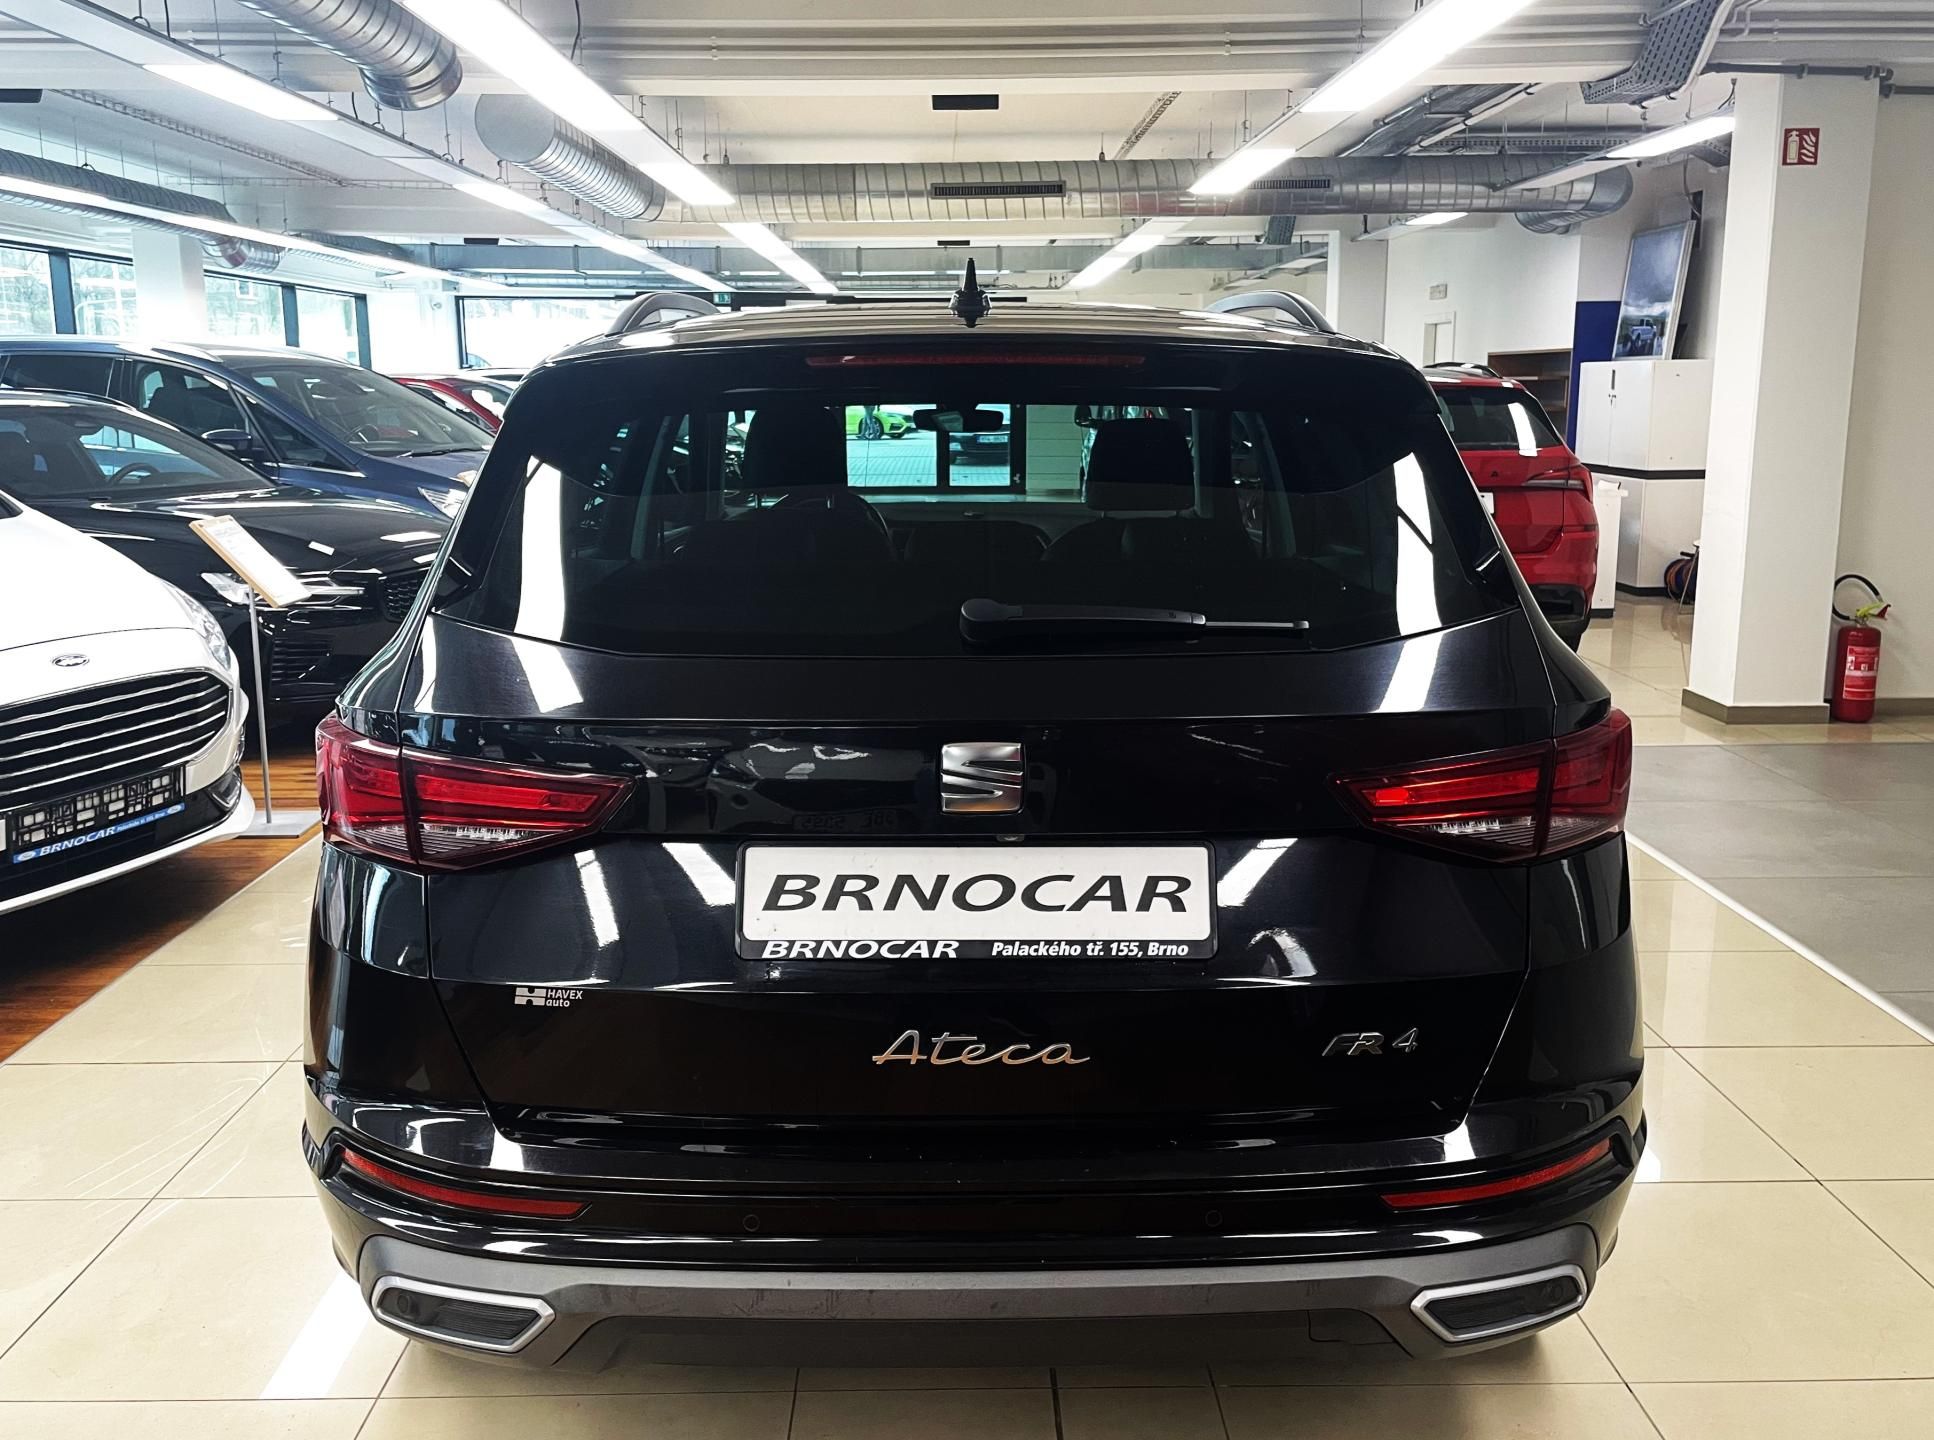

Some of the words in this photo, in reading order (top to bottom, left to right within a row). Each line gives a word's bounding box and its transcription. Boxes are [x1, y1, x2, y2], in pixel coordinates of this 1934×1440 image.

[39, 826, 116, 856] BRNOCAR
[762, 874, 1192, 912] BRNOCAR
[761, 940, 960, 959] BRNOCAR
[991, 941, 1082, 957] Palackého
[1086, 942, 1105, 957] tř.
[1109, 941, 1144, 959] 155,
[1147, 942, 1190, 957] Brno
[546, 998, 571, 1008] auto
[547, 988, 583, 1000] HAVEX
[871, 1028, 1091, 1066] Ateca
[1321, 1031, 1385, 1057] FR
